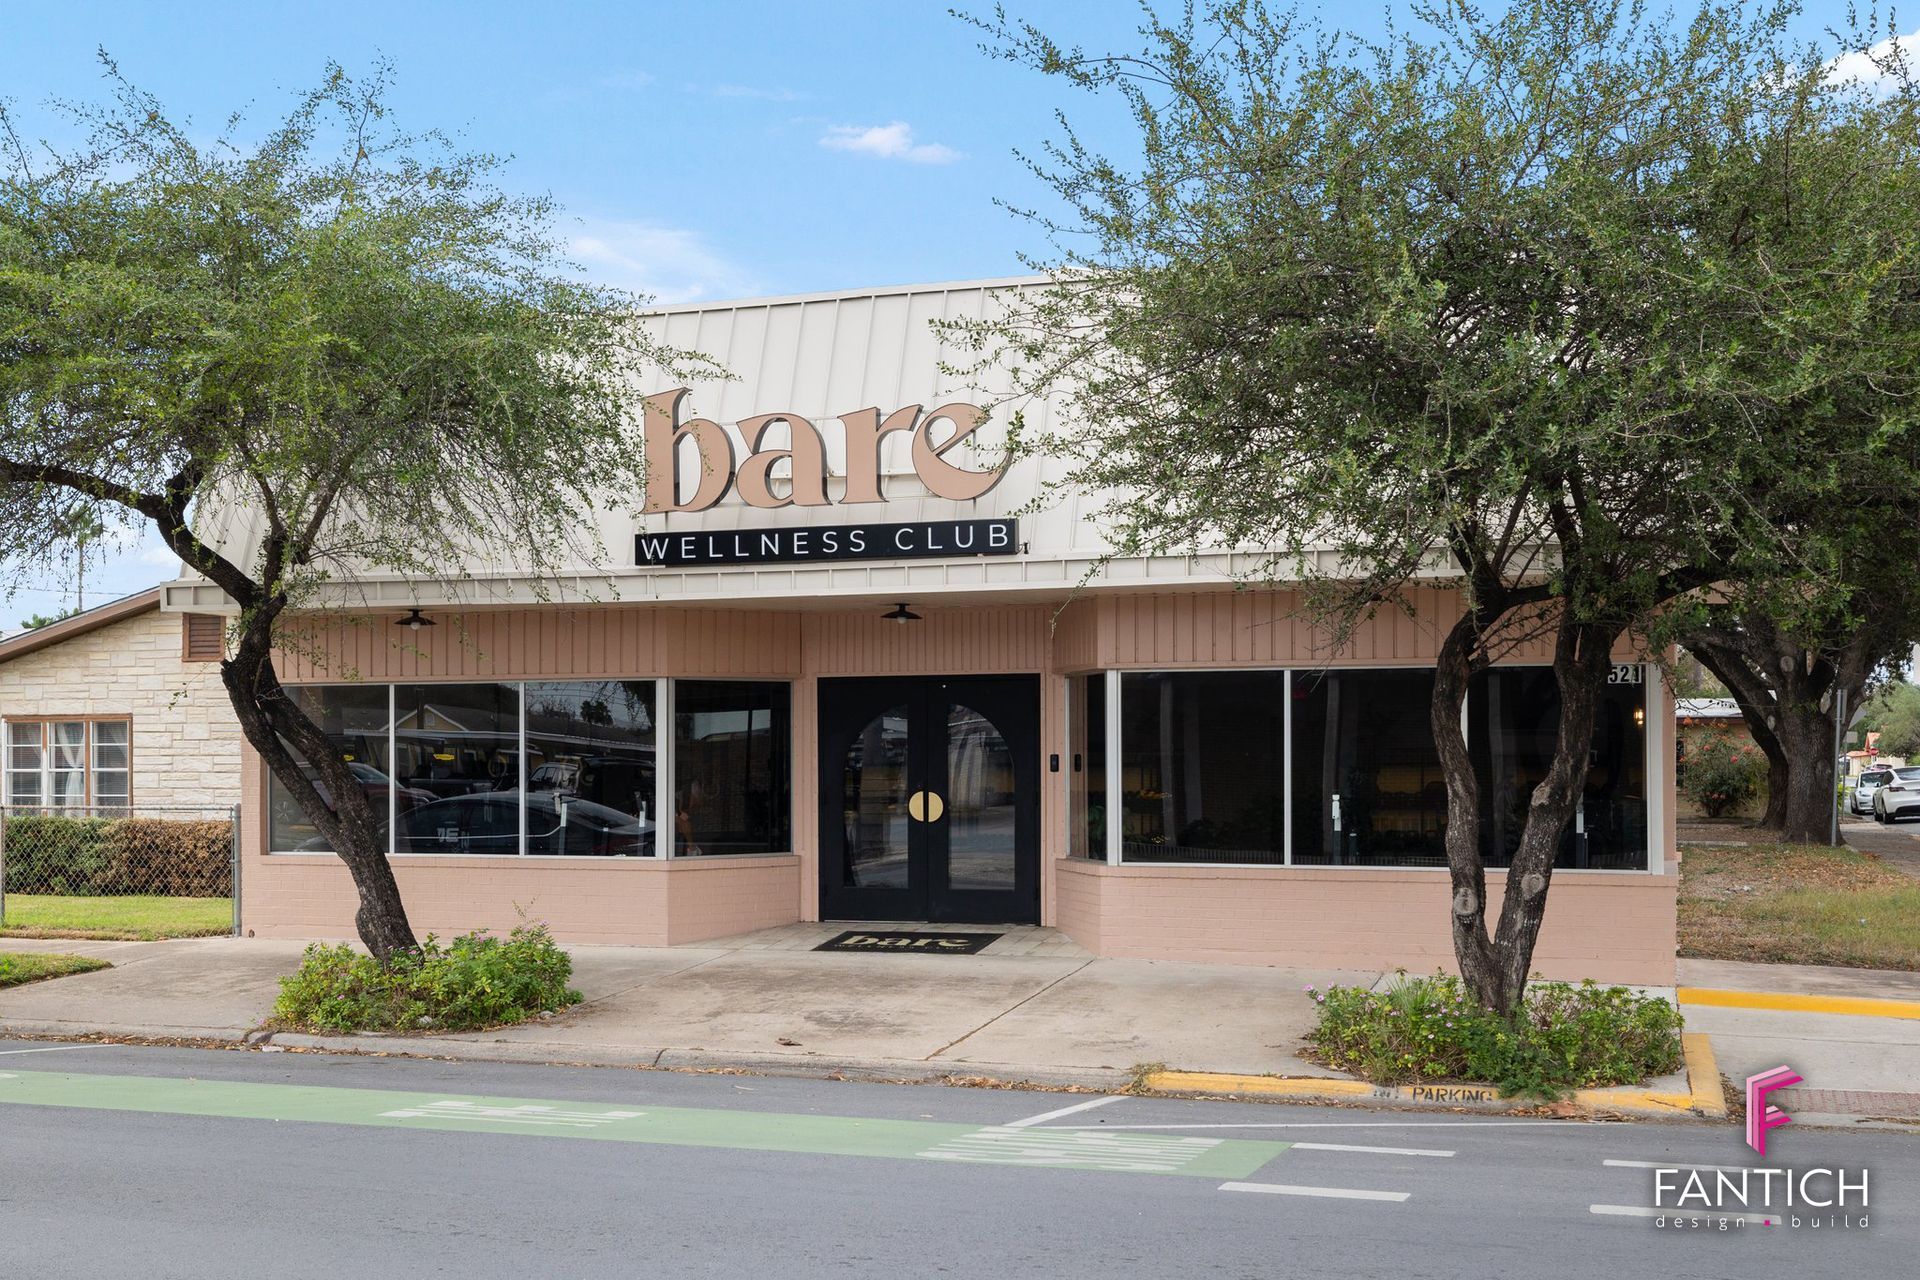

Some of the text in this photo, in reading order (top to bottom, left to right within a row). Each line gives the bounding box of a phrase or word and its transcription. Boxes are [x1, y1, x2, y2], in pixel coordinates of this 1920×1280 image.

[640, 387, 1013, 515] bare
[641, 523, 1009, 561] WELLNESS CLUB
[1609, 665, 1640, 683] 521
[1412, 1086, 1492, 1103] PARKING
